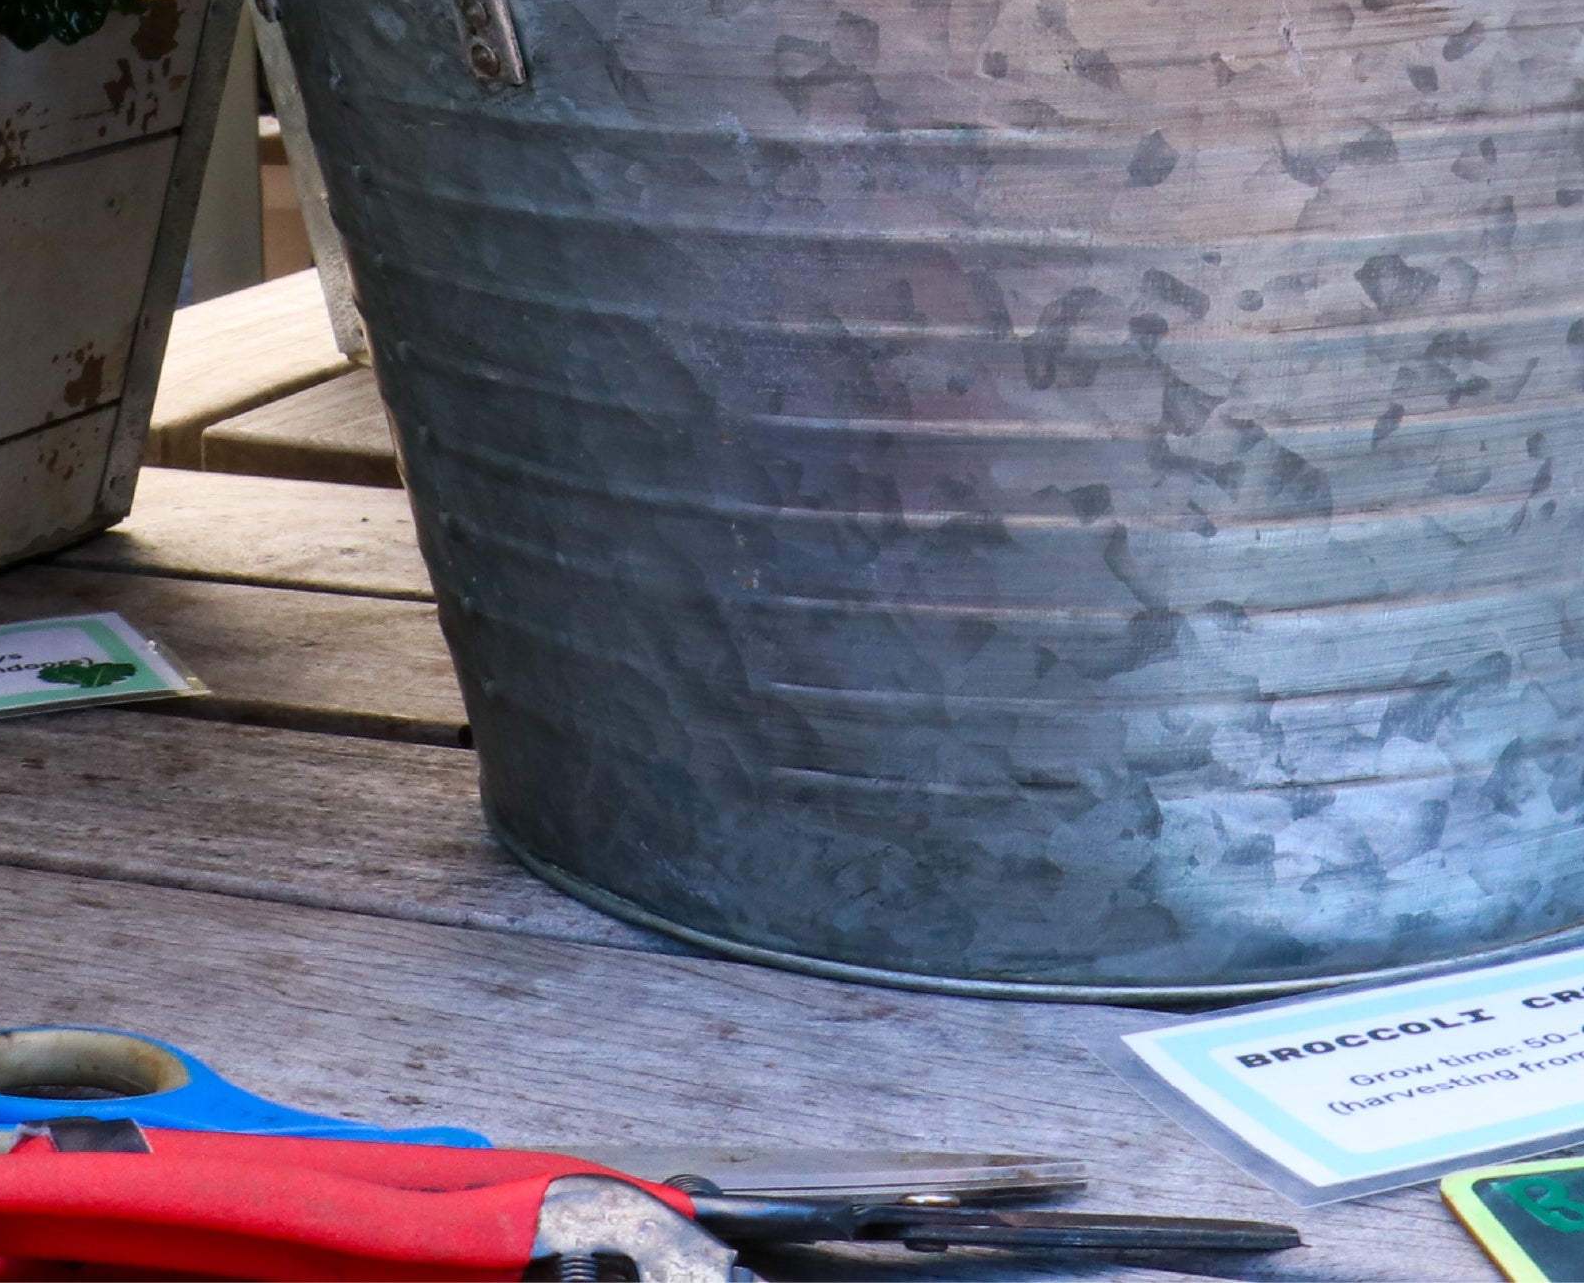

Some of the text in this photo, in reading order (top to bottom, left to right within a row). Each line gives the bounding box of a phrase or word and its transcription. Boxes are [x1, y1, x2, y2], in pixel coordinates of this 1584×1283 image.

[1235, 1008, 1496, 1068] BROCCOLI
[1349, 1063, 1434, 1087] Grow
[1437, 1045, 1523, 1067] time:
[1327, 1067, 1519, 1116] (harvesting
